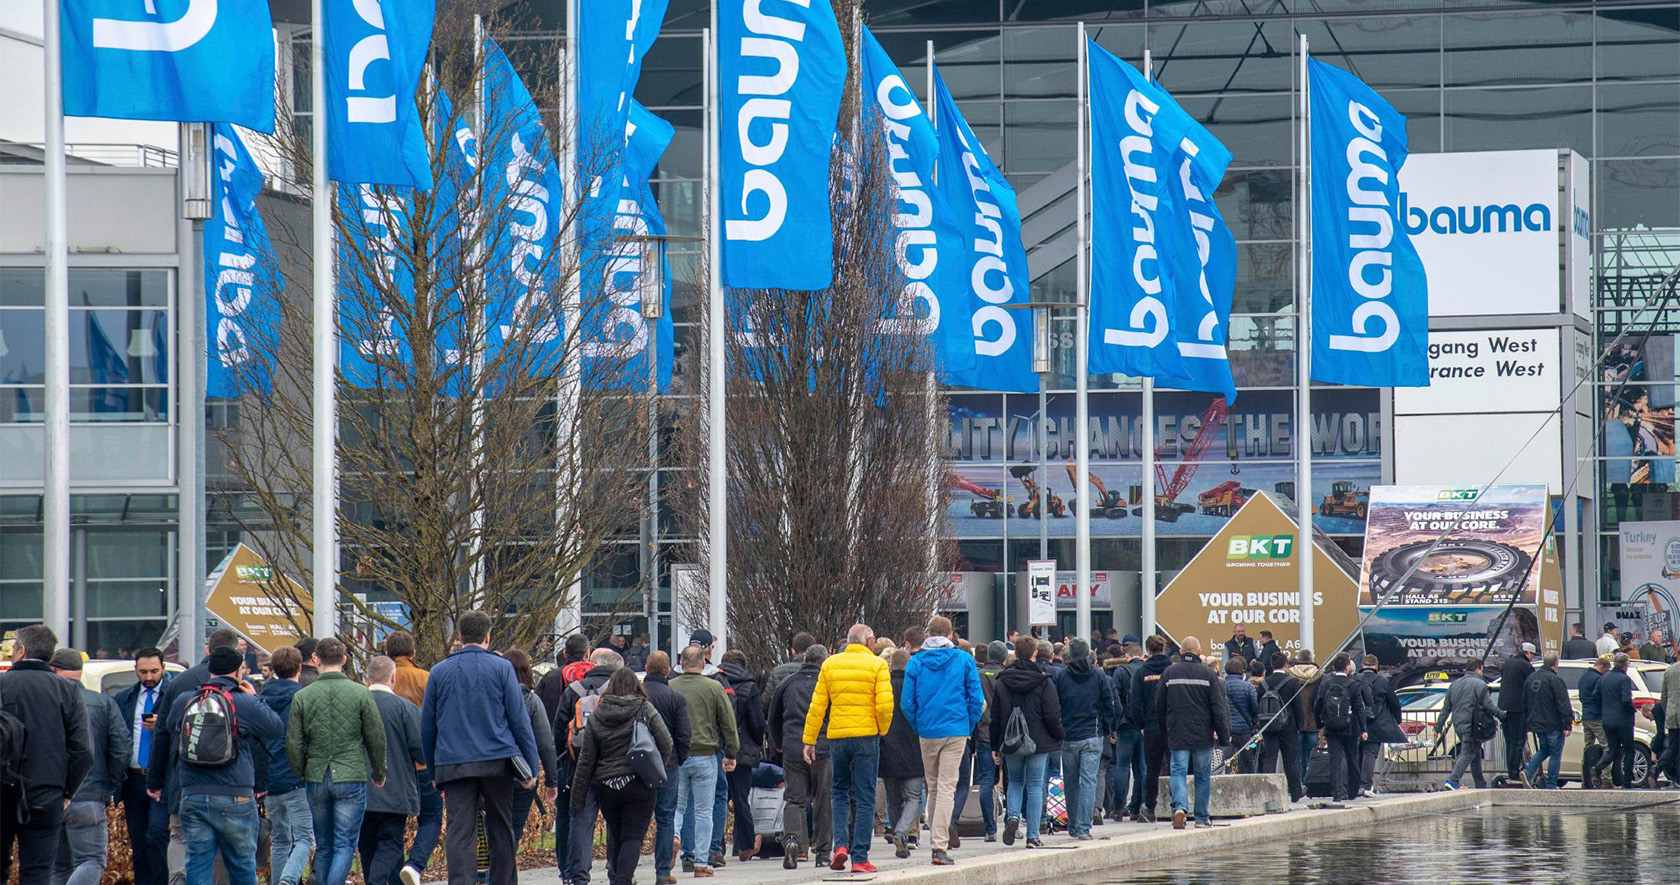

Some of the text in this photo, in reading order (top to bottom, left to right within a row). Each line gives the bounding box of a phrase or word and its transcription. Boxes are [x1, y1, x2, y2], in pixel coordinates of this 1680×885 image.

[1400, 192, 1551, 235] bauma
[1329, 100, 1401, 353] bauma
[1488, 337, 1538, 352] West
[1429, 360, 1544, 378] rance West
[1223, 413, 1291, 458] THE
[1438, 490, 1477, 499] BKT
[1404, 511, 1442, 520] YOUR
[1409, 521, 1426, 530] AT
[1461, 520, 1500, 529] CORE.
[1624, 531, 1657, 545] Turkey
[1229, 539, 1291, 554] BKT
[1199, 592, 1244, 607] YOUR
[1207, 609, 1228, 624] AT
[1231, 609, 1266, 624] OUR
[1428, 613, 1467, 621] BKT
[1399, 638, 1437, 648] YOUR
[1407, 649, 1424, 658] AT
[1427, 649, 1456, 657] OUR
